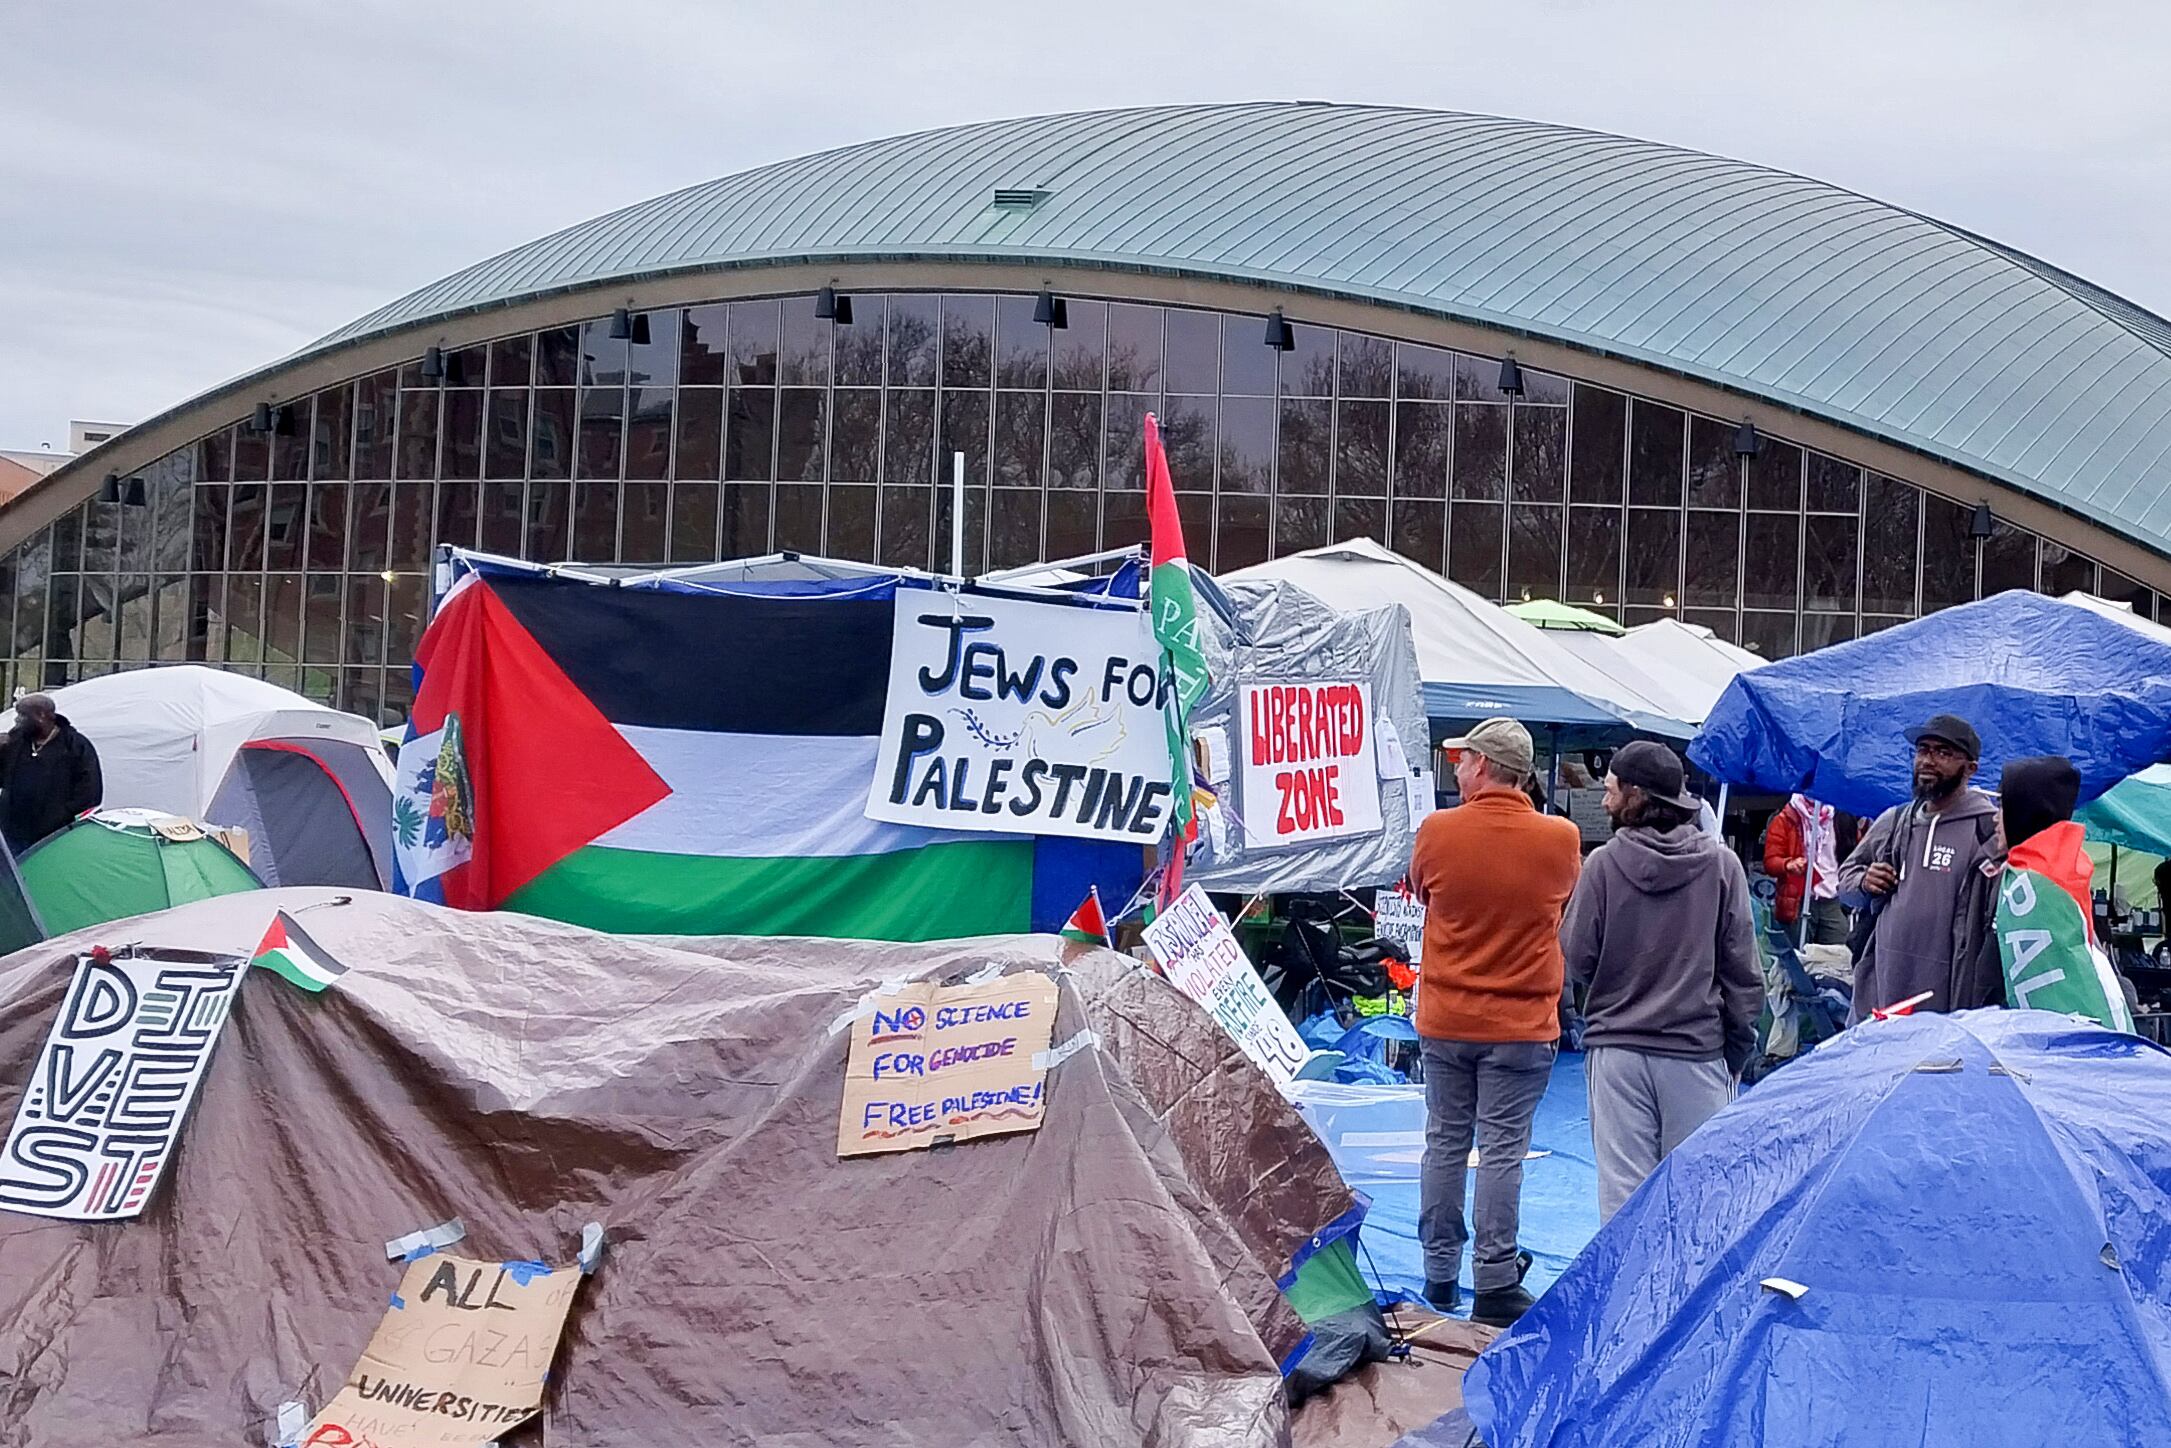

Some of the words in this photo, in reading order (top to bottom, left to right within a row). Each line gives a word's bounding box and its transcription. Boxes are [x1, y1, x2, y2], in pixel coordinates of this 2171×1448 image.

[917, 614, 1079, 709] JEWS
[1250, 684, 1364, 766] LIBERATED
[888, 713, 1172, 834] PALESTINE
[1275, 765, 1344, 834] ZONE
[1931, 852, 1952, 867] 26
[1150, 890, 1217, 969] ISRAEL
[1180, 939, 1238, 1000] VIOLATED
[1212, 971, 1234, 1001] EVERY
[872, 1006, 926, 1035] NO
[935, 1001, 1030, 1031] SCIENCE
[873, 1052, 925, 1081] FOR
[929, 1038, 1017, 1071] GENOCIDE
[863, 1102, 936, 1128] FREE
[942, 1081, 1041, 1116] PALESTINE!
[420, 1260, 516, 1310] ALL
[359, 1374, 537, 1423] UNIVERSITIES
[344, 1413, 408, 1436] HAVE
